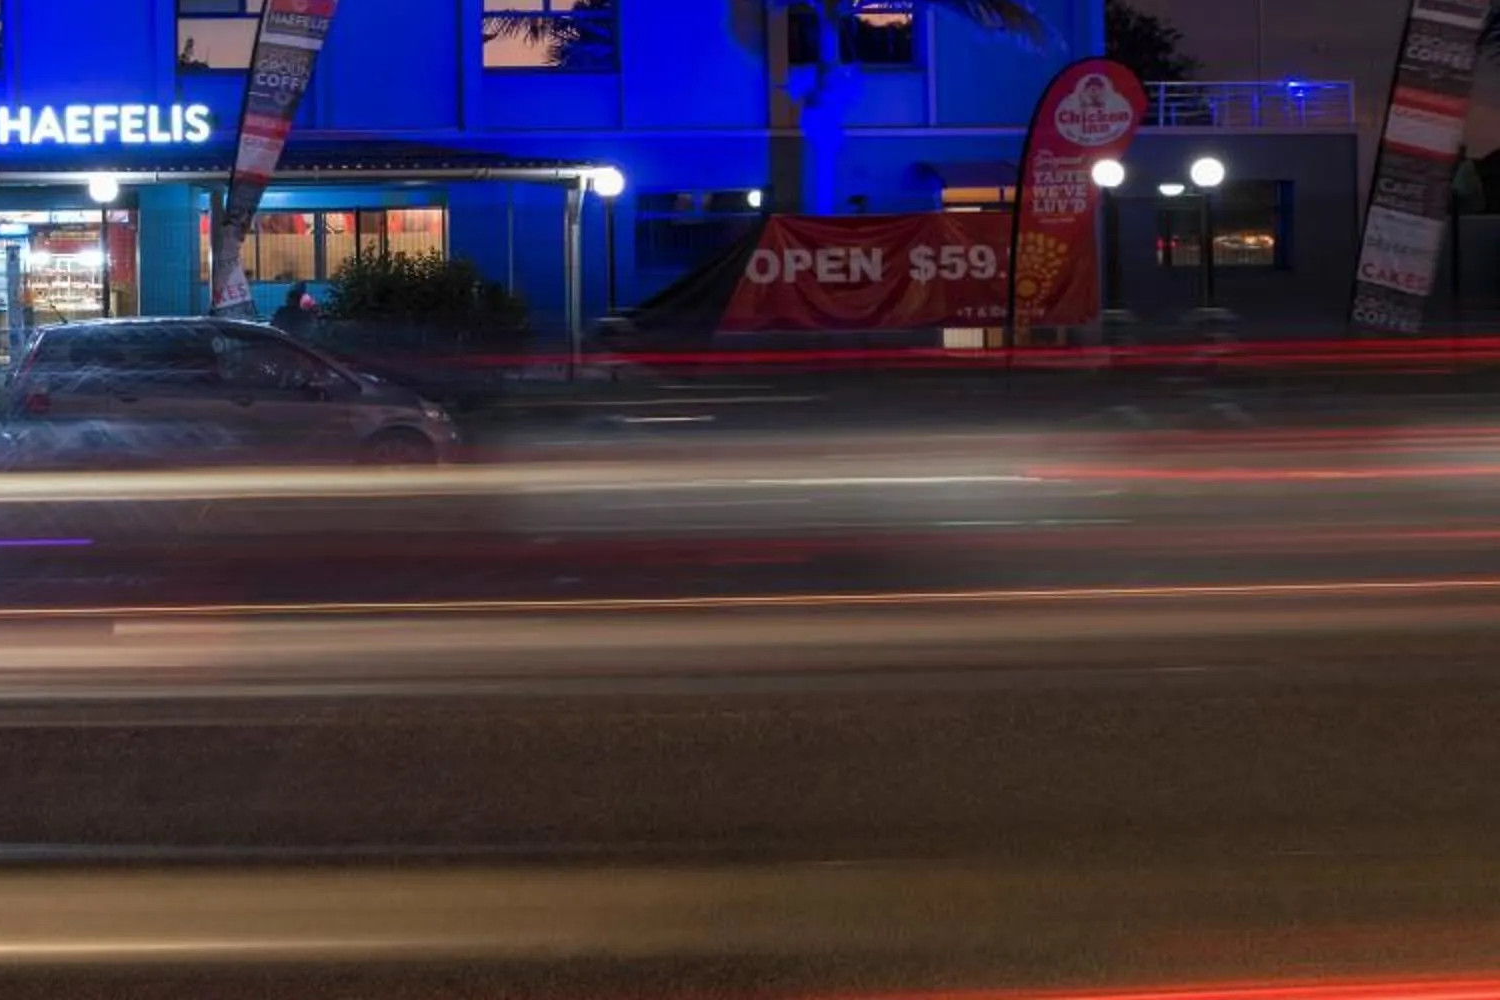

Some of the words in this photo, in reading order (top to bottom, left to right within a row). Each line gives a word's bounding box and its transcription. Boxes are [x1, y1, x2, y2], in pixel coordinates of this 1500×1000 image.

[1058, 110, 1131, 125] Chicken
[745, 248, 882, 284] OPEN
[909, 244, 1011, 284] $59.
